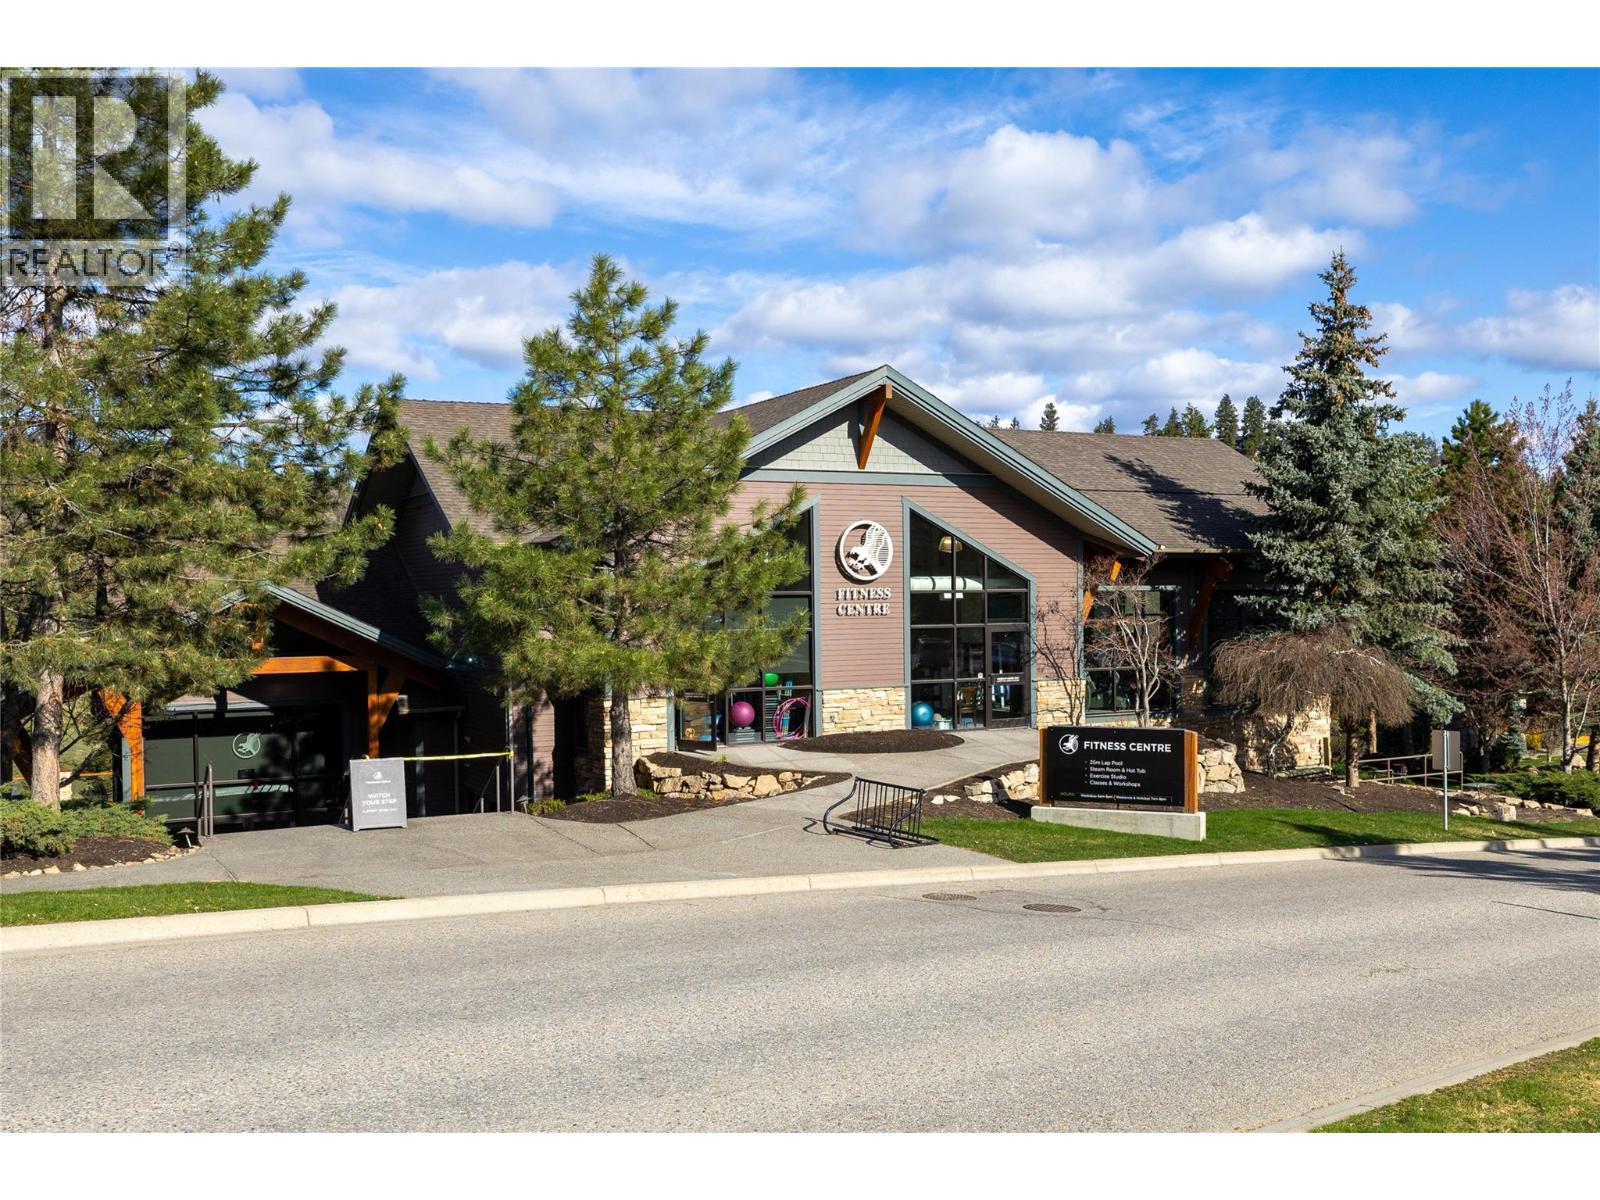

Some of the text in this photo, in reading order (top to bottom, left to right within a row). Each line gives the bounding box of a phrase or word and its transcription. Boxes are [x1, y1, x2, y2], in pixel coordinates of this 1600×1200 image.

[837, 587, 891, 600] FITNESS
[837, 603, 890, 615] CENTRE
[1084, 741, 1172, 753] FITNESS CENTRE
